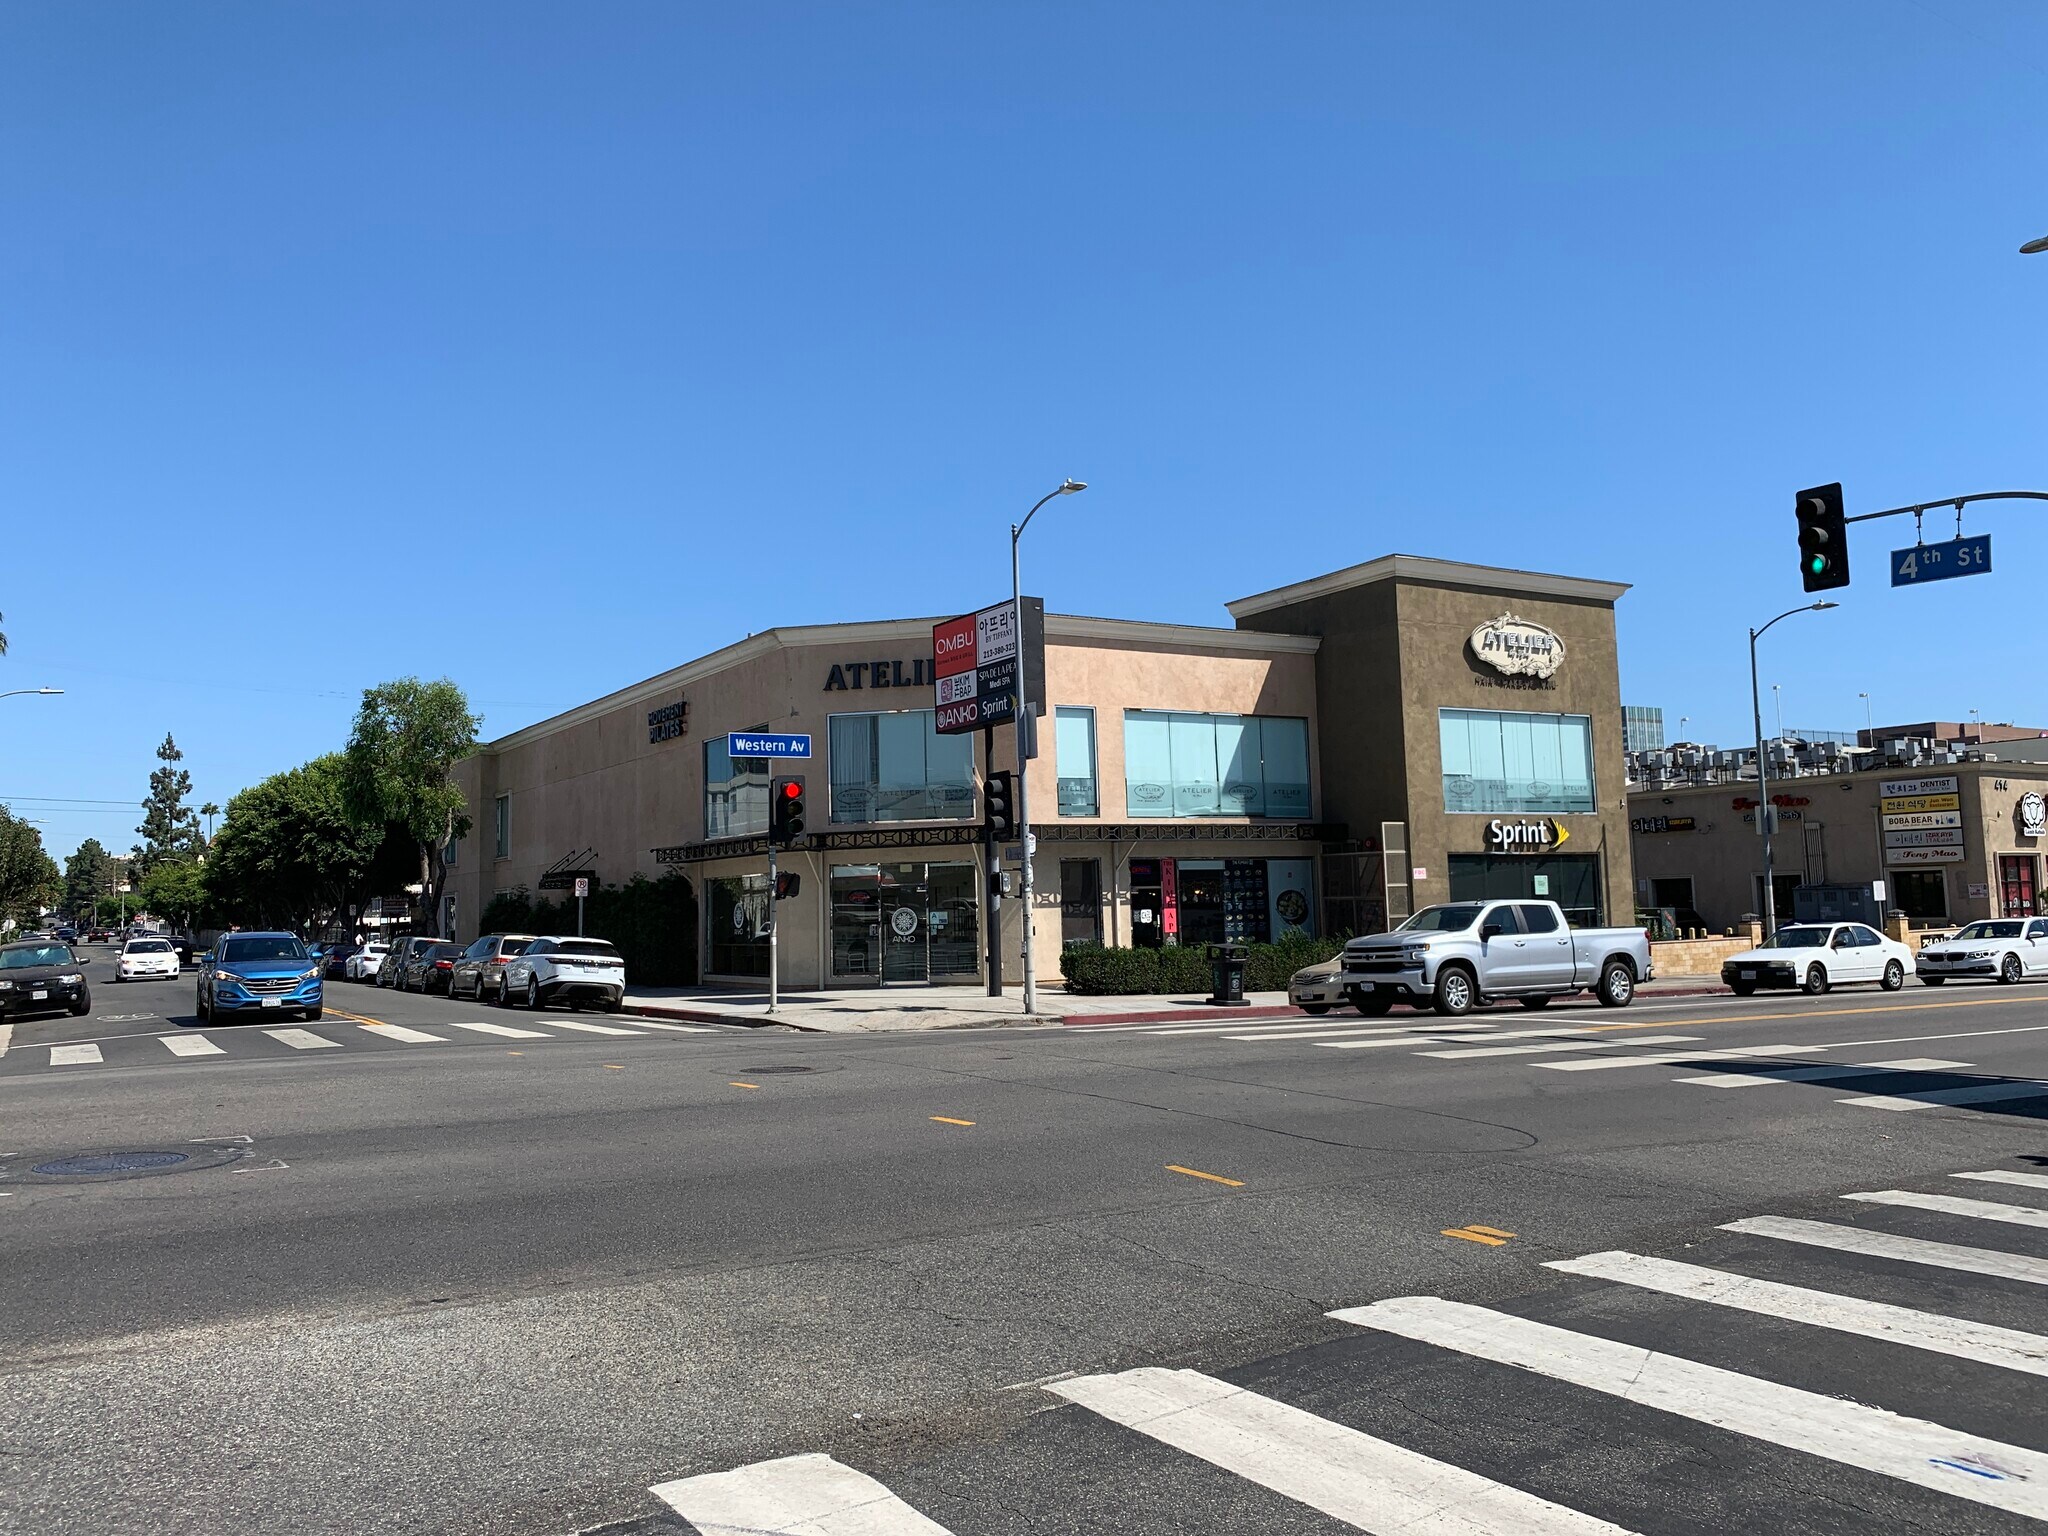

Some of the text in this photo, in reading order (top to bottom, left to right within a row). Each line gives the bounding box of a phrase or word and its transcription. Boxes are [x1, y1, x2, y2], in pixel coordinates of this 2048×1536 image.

[1899, 545, 1983, 579] 4th St
[936, 631, 974, 655] OMBU
[985, 628, 1013, 643] BY TIFFANY
[1484, 630, 1555, 649] ATELIER
[823, 659, 936, 691] ATELI
[960, 674, 970, 686] KIM
[979, 670, 990, 682] SPA
[990, 668, 997, 679] DE
[997, 665, 1006, 677] LA
[960, 685, 972, 698] BAP
[989, 677, 1011, 689] Medi SPA
[648, 703, 686, 726] MOVEMENT
[945, 703, 978, 725] ANKO
[982, 696, 1008, 718] Sprint
[649, 719, 683, 744] PILATES
[735, 738, 805, 752] Western Av
[1920, 779, 1951, 788] DENTIST
[1889, 815, 1933, 825] BOBA BEAR
[1491, 819, 1547, 849] Sprint
[1902, 849, 1958, 859] Feng Mao
[892, 935, 916, 943] ANKO
